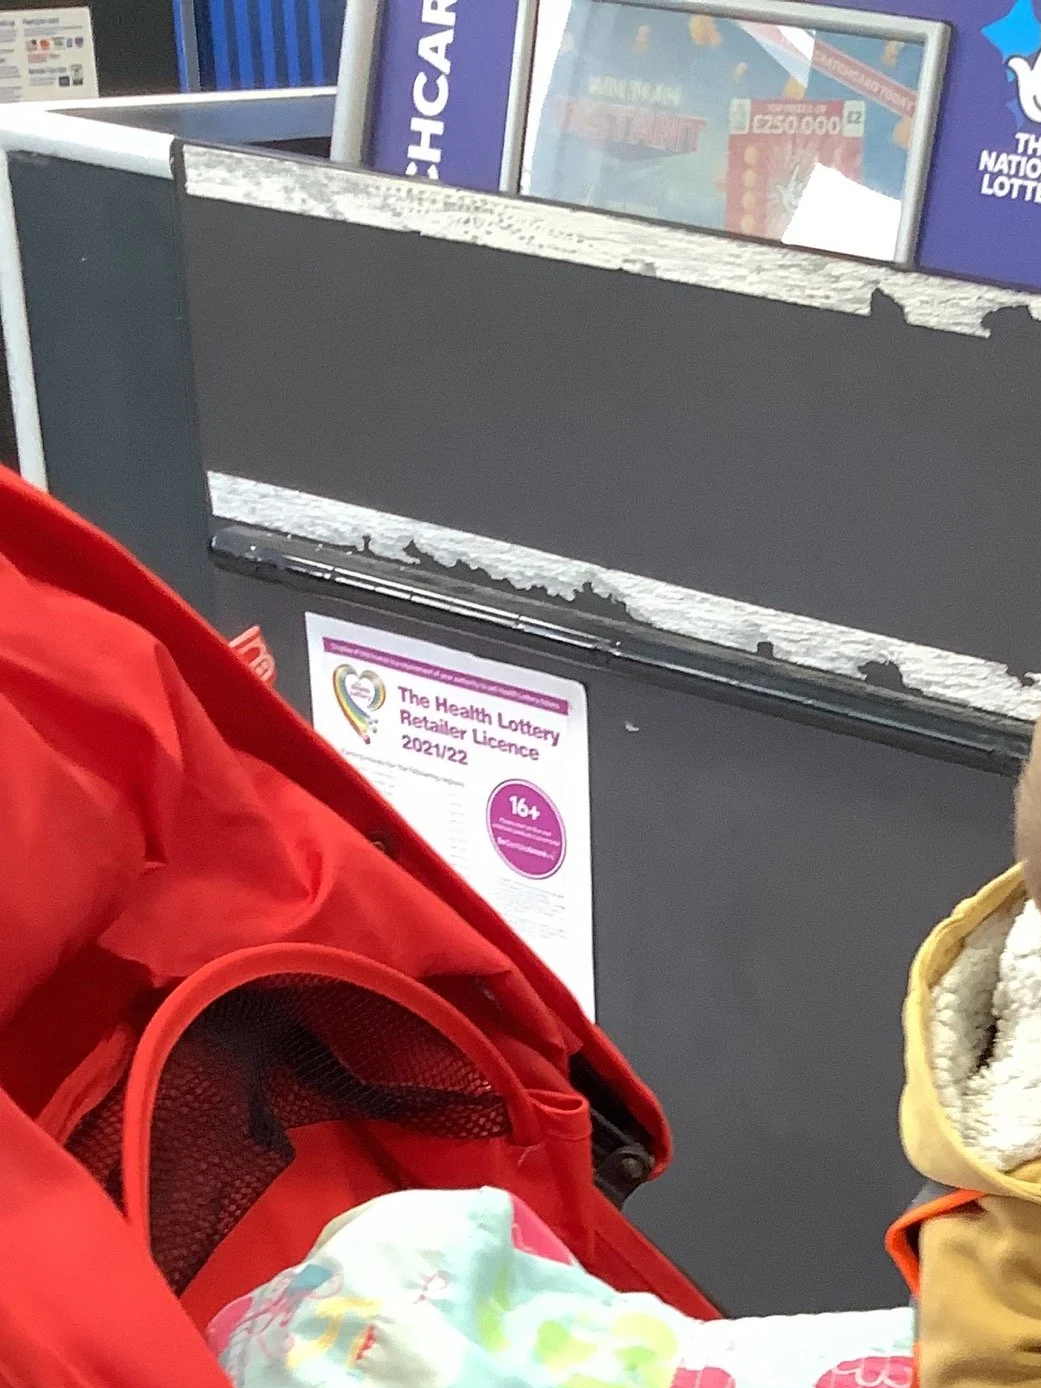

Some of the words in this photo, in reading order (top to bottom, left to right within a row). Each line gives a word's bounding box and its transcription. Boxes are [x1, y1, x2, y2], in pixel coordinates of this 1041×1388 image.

[847, 111, 862, 124] £2
[397, 685, 430, 709] The
[434, 695, 492, 725] Health
[497, 712, 561, 747] Lottery
[400, 709, 468, 740] Retailer
[472, 728, 540, 761] Licence
[402, 734, 469, 766] 2021/22
[509, 795, 540, 821] 16+
